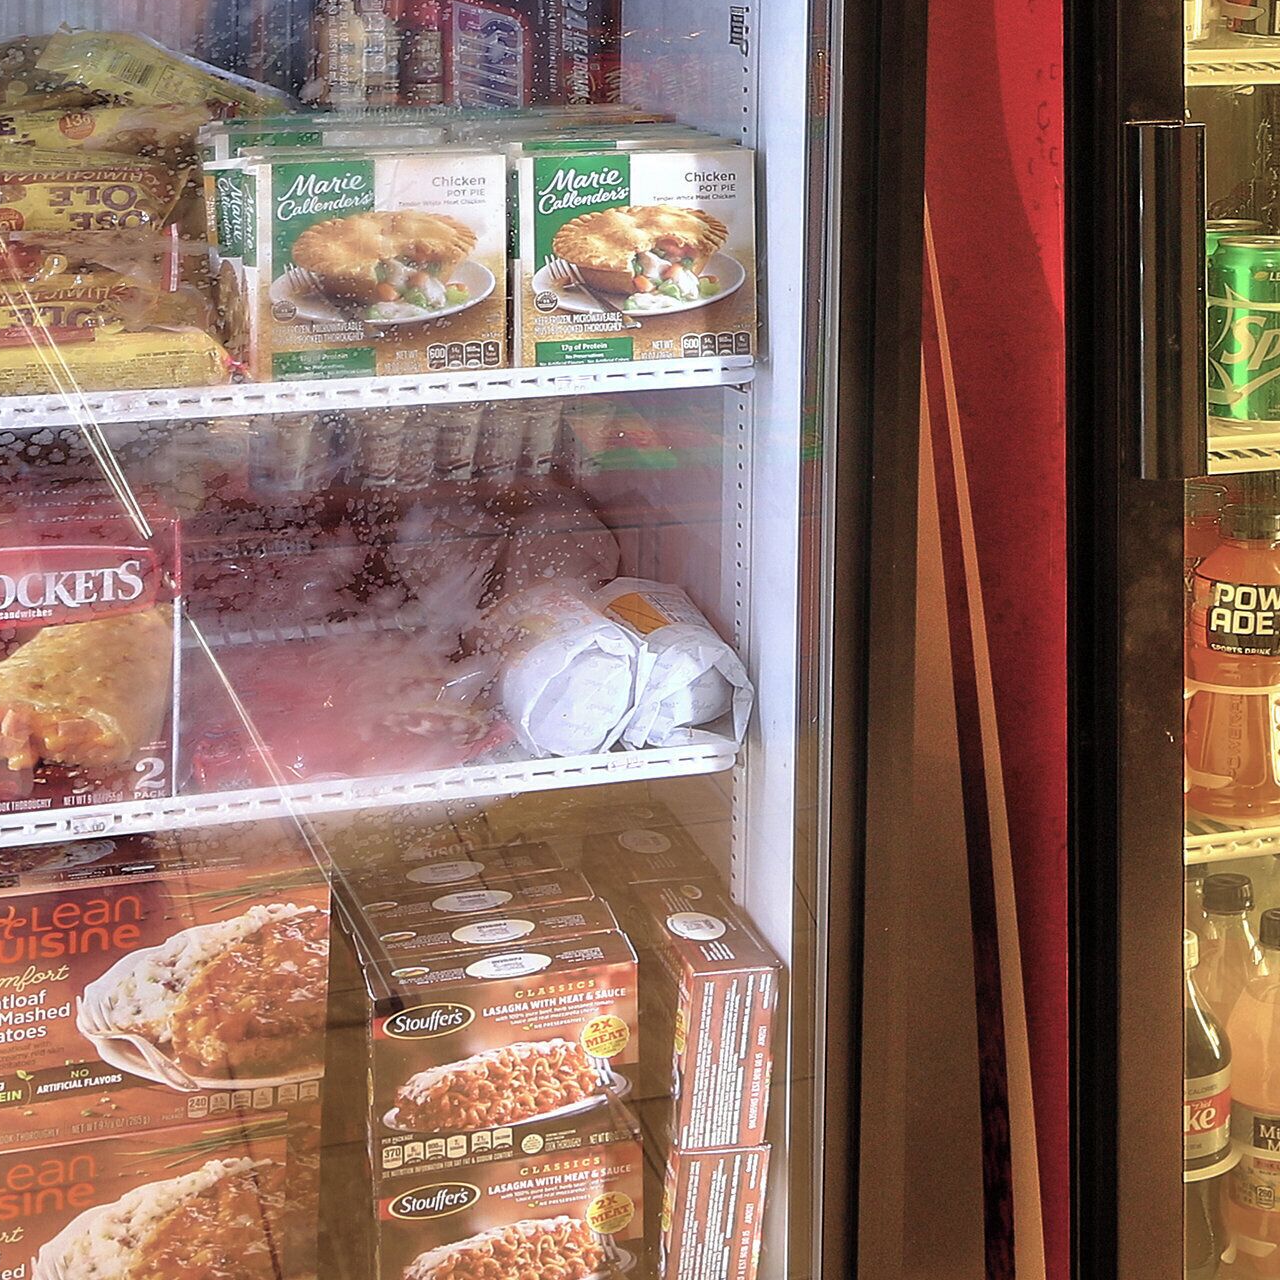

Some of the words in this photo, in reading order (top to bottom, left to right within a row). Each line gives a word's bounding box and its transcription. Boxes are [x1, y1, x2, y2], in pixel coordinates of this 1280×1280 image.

[432, 176, 486, 188] Chicken
[539, 168, 623, 196] Marie
[685, 172, 736, 183] Chicken
[278, 172, 366, 202] Marie
[447, 189, 466, 197] POT
[699, 184, 717, 192] POT
[277, 190, 373, 221] Callender's
[539, 186, 629, 215] Callender's
[583, 342, 608, 350] Protein
[684, 338, 699, 349] 600
[429, 347, 445, 360] 600
[1211, 644, 1243, 654] SPORTS
[1244, 647, 1271, 655] DRINK
[134, 757, 166, 790] 2
[134, 790, 165, 800] PACK
[515, 979, 596, 999] CLASSICS
[482, 1002, 529, 1018] LASAGNA
[530, 998, 556, 1011] WITH
[558, 995, 585, 1007] MEAT
[595, 987, 627, 1000] SAUCE
[393, 1008, 464, 1034] Stouffer's
[589, 1018, 614, 1033] 2X
[584, 1028, 629, 1049] MEAT
[70, 1068, 90, 1078] NO
[36, 1079, 83, 1095] ARTIFICIAL
[83, 1074, 123, 1087] FLAVORS
[384, 1147, 402, 1158] 370
[520, 1156, 601, 1176] CLASSICS
[487, 1179, 534, 1195] LASAGNA
[535, 1175, 563, 1188] WITH
[564, 1171, 590, 1183] MEAT
[600, 1164, 632, 1177] SAUCE
[399, 1187, 470, 1214] Stouffer's
[1258, 1188, 1273, 1199] 260
[595, 1195, 618, 1211] 2X
[590, 1204, 629, 1226] MEAT
